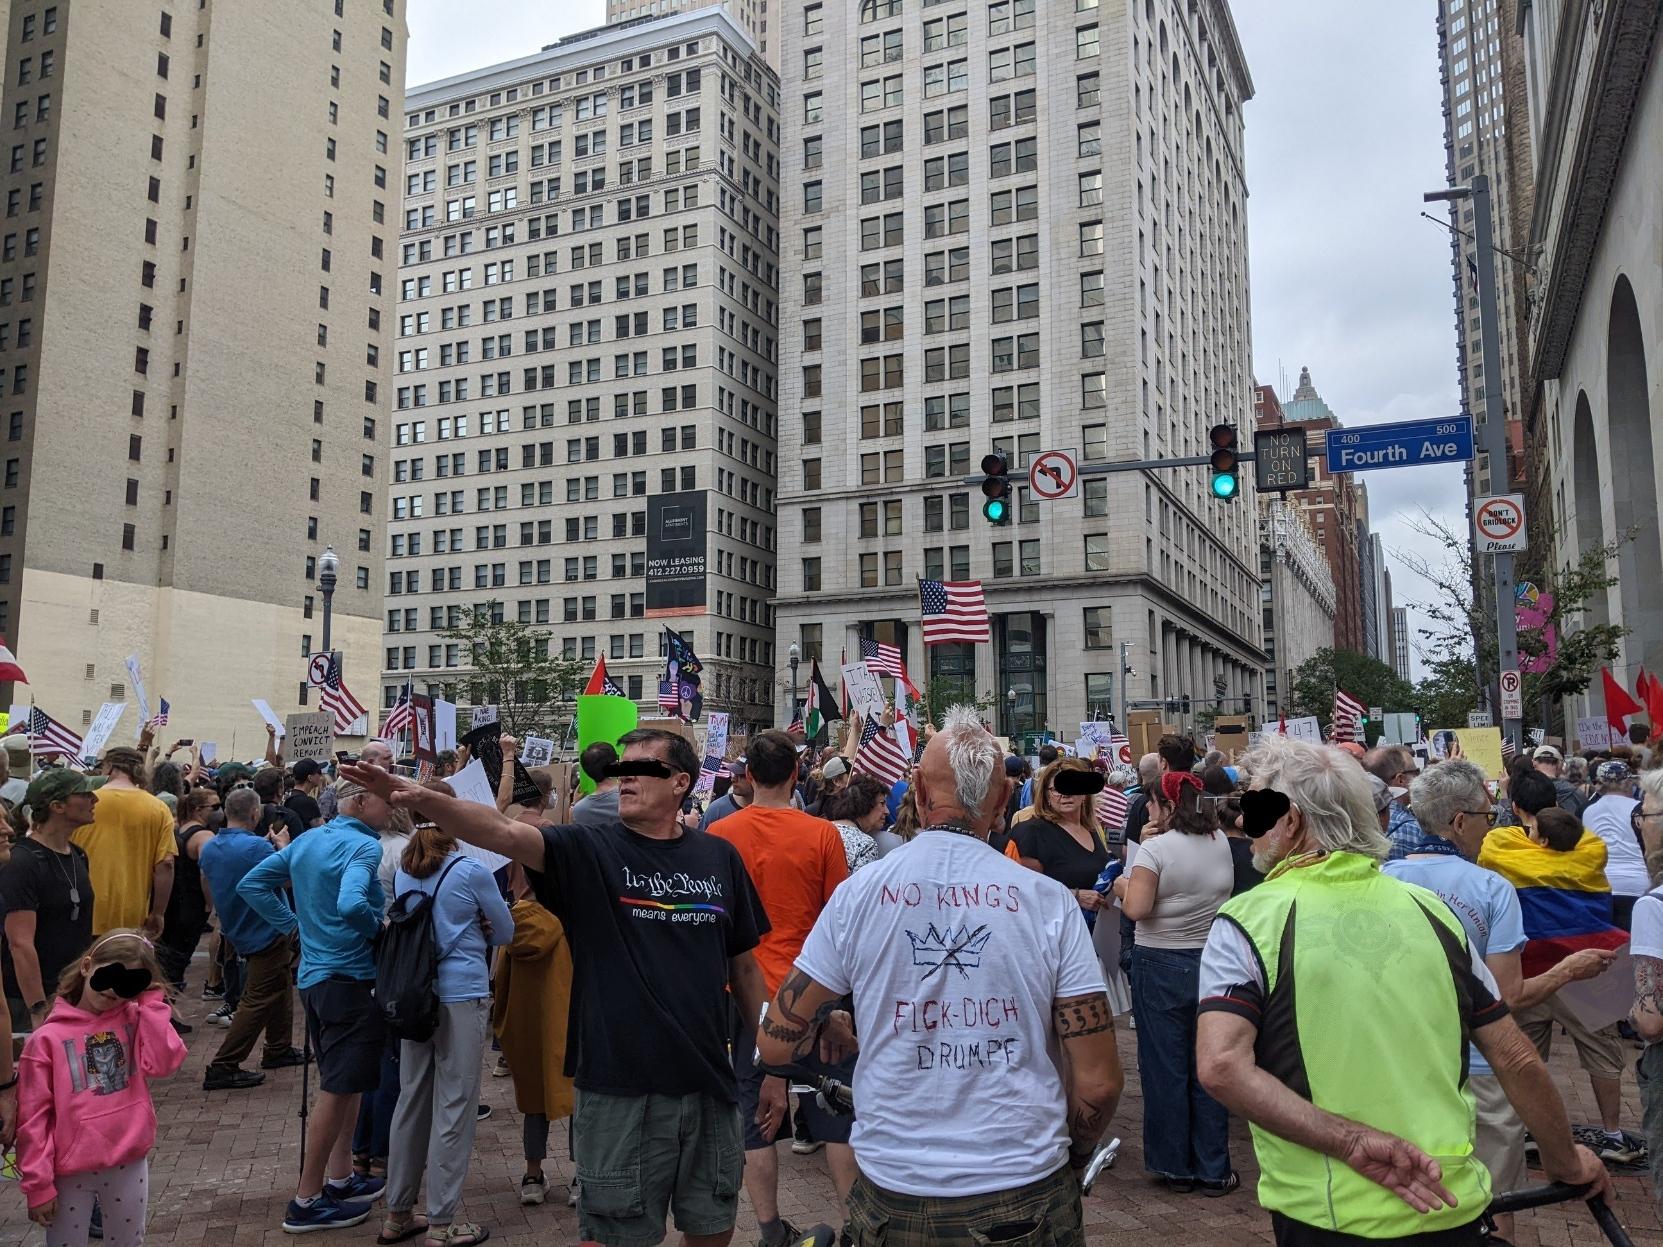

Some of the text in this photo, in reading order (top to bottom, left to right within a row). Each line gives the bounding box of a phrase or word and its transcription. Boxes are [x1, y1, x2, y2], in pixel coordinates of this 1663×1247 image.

[1341, 424, 1456, 443] 400 500
[1270, 434, 1289, 446] NO
[1261, 445, 1300, 458] TURN
[1341, 441, 1457, 466] Fourth Ave
[1272, 459, 1291, 471] ON
[1267, 472, 1297, 484] RED
[1483, 517, 1516, 526] GRIDLOCK
[1487, 542, 1516, 551] Please
[648, 556, 705, 567] NOW LEASING
[648, 565, 704, 576] 412.227.0959
[293, 725, 329, 737] IMPEACH
[293, 735, 331, 747] CONVICT
[293, 748, 324, 758] REMOVE
[622, 866, 646, 890] We
[672, 873, 723, 902] People
[881, 882, 1020, 913] NO KINGS
[632, 908, 716, 926] means everyone
[1449, 894, 1468, 910] Her
[1467, 908, 1488, 938] Union
[917, 1037, 1019, 1070] DRUMPF
